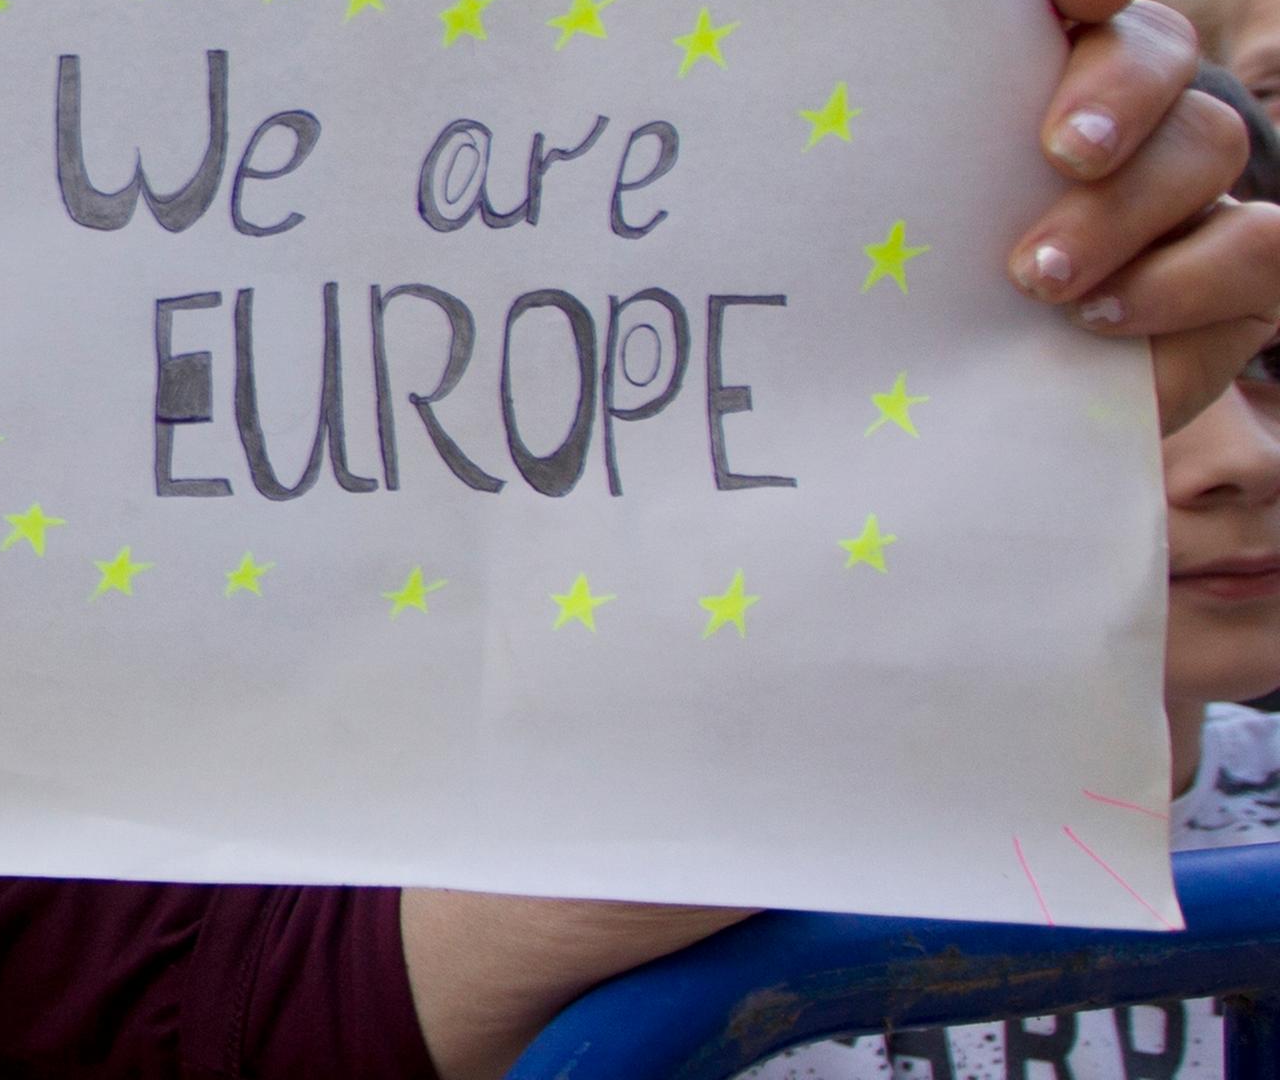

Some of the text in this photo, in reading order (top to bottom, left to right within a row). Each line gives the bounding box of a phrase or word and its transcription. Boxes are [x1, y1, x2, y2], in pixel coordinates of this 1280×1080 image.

[55, 48, 680, 240] We are
[153, 280, 798, 502] EUROPE
